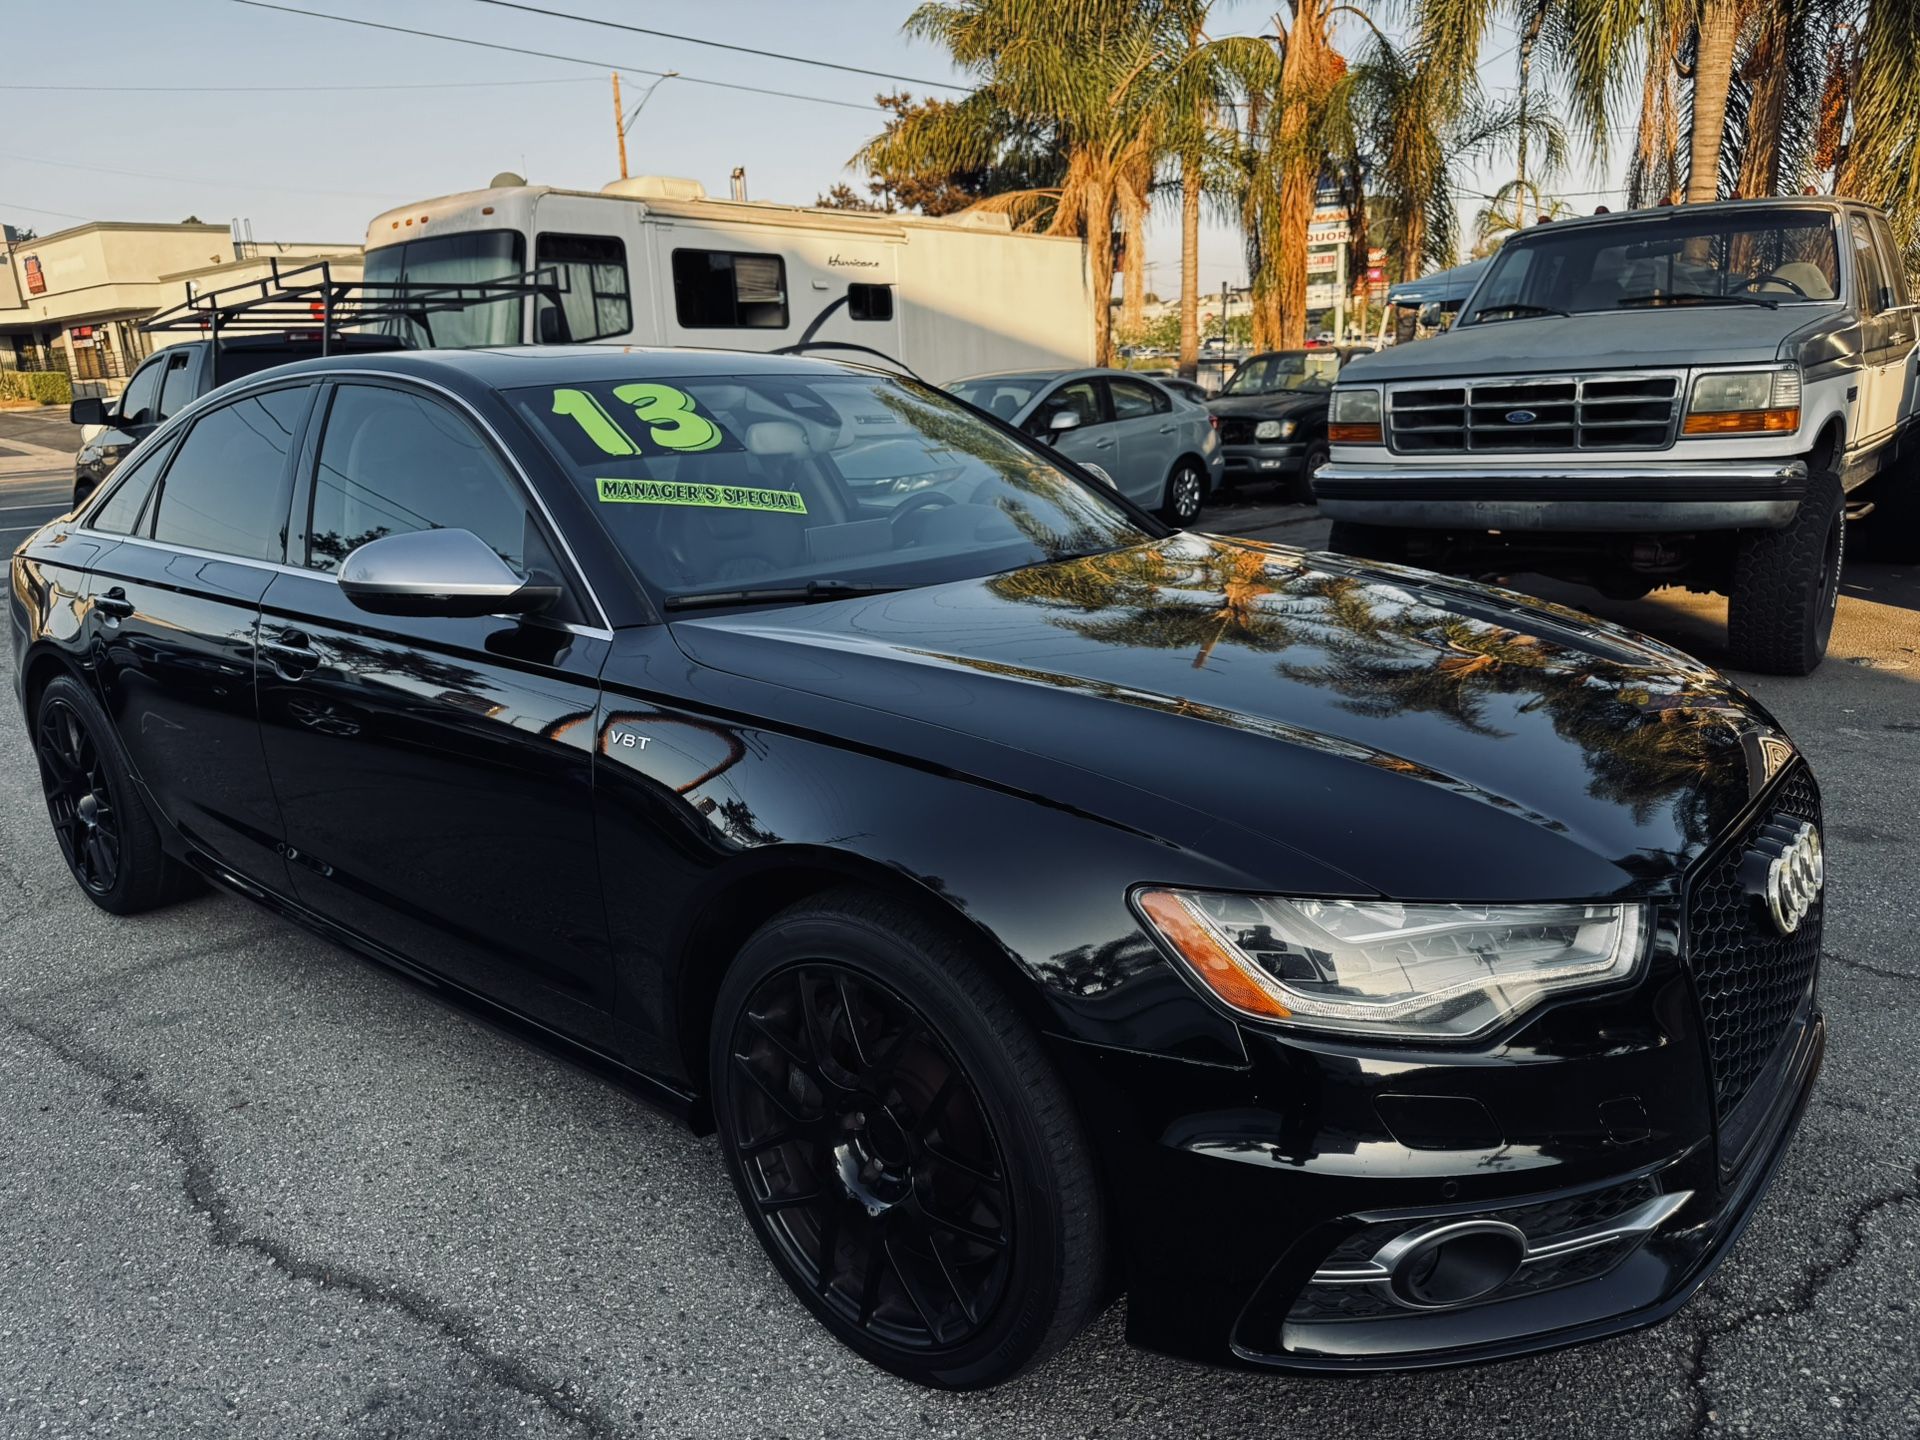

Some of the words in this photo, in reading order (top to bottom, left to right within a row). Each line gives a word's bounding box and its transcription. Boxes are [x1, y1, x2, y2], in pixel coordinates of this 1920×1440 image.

[1306, 231, 1347, 242] QUOR
[551, 383, 723, 456] 13
[602, 480, 719, 503] MANAGER'S
[722, 488, 803, 510] SPECIAL
[610, 730, 651, 750] V8T
